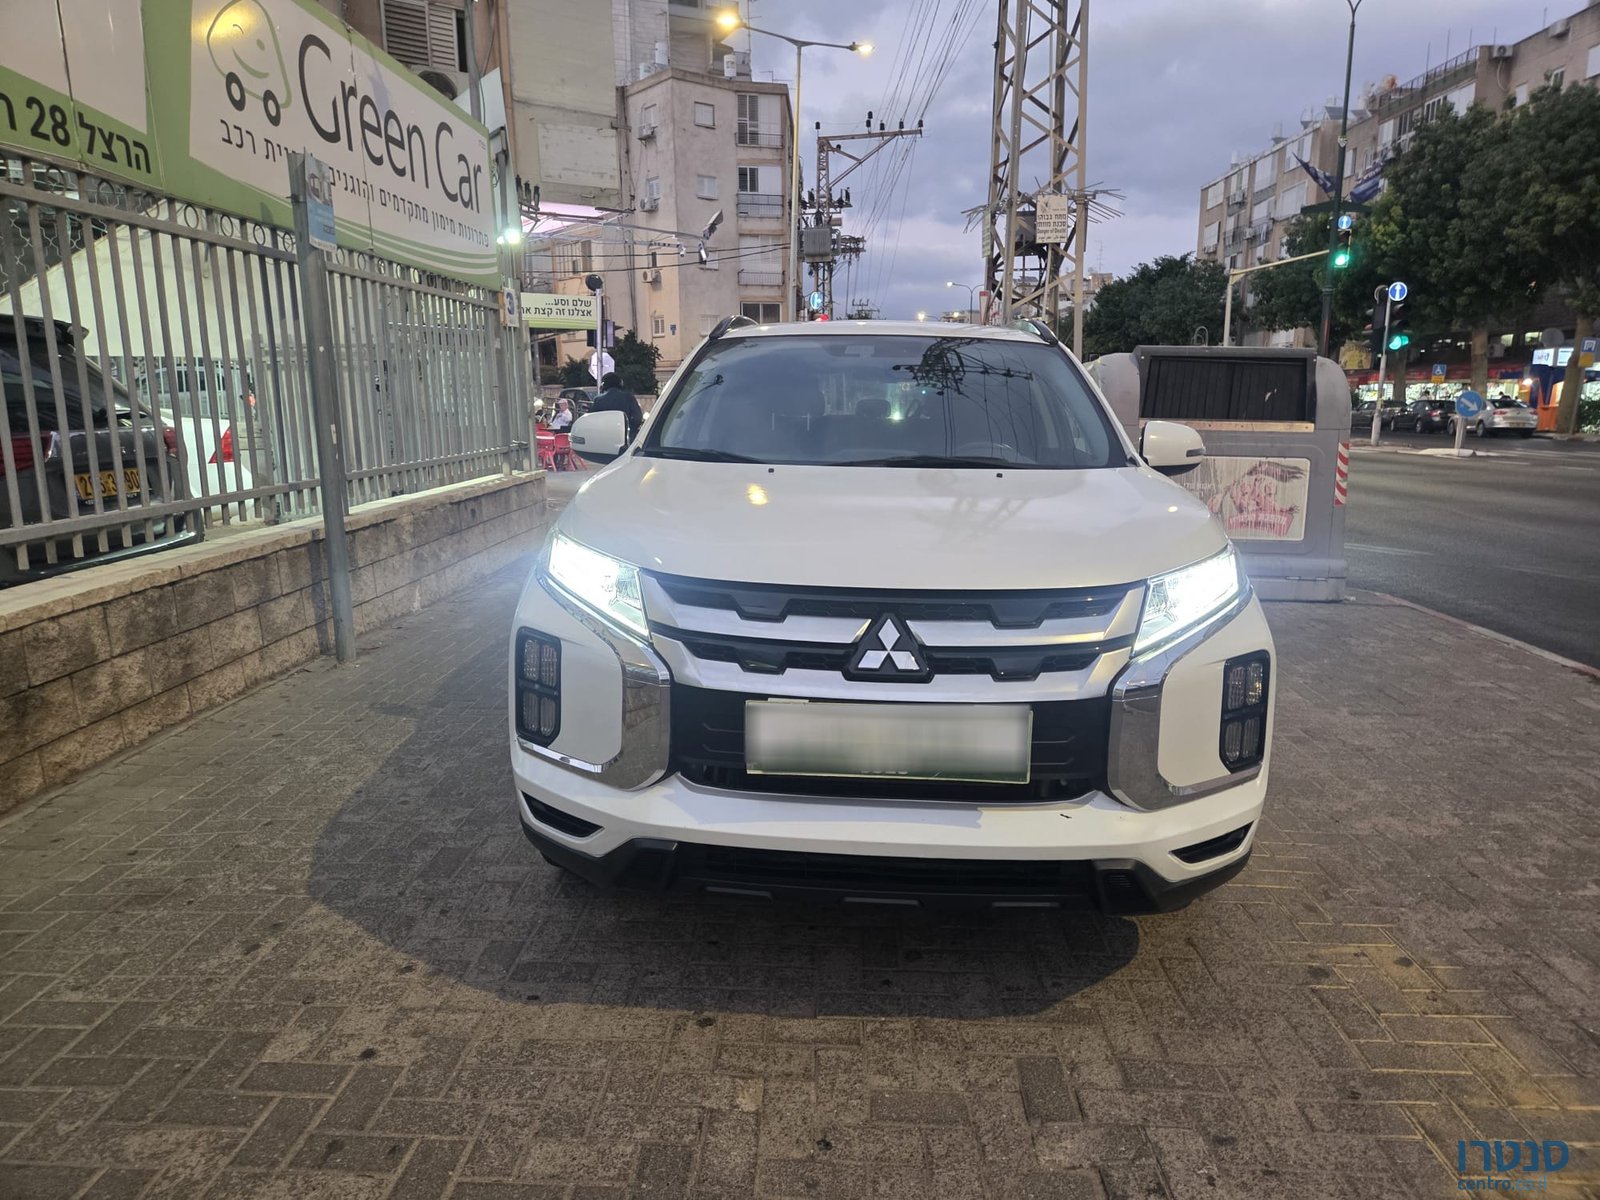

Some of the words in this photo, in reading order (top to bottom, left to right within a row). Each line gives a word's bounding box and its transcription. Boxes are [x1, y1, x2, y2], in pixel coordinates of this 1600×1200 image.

[26, 96, 70, 147] 28
[298, 34, 429, 189] Green
[435, 121, 482, 214] Car
[78, 111, 151, 174] הרצל
[220, 119, 256, 154] רכב
[379, 188, 429, 224] מתקדמים
[431, 211, 456, 234] מימון
[458, 222, 489, 248] פתרונות
[534, 305, 553, 318] קצת
[555, 307, 566, 317] זה
[568, 307, 592, 317] אצלנו
[572, 297, 592, 307] שלם
